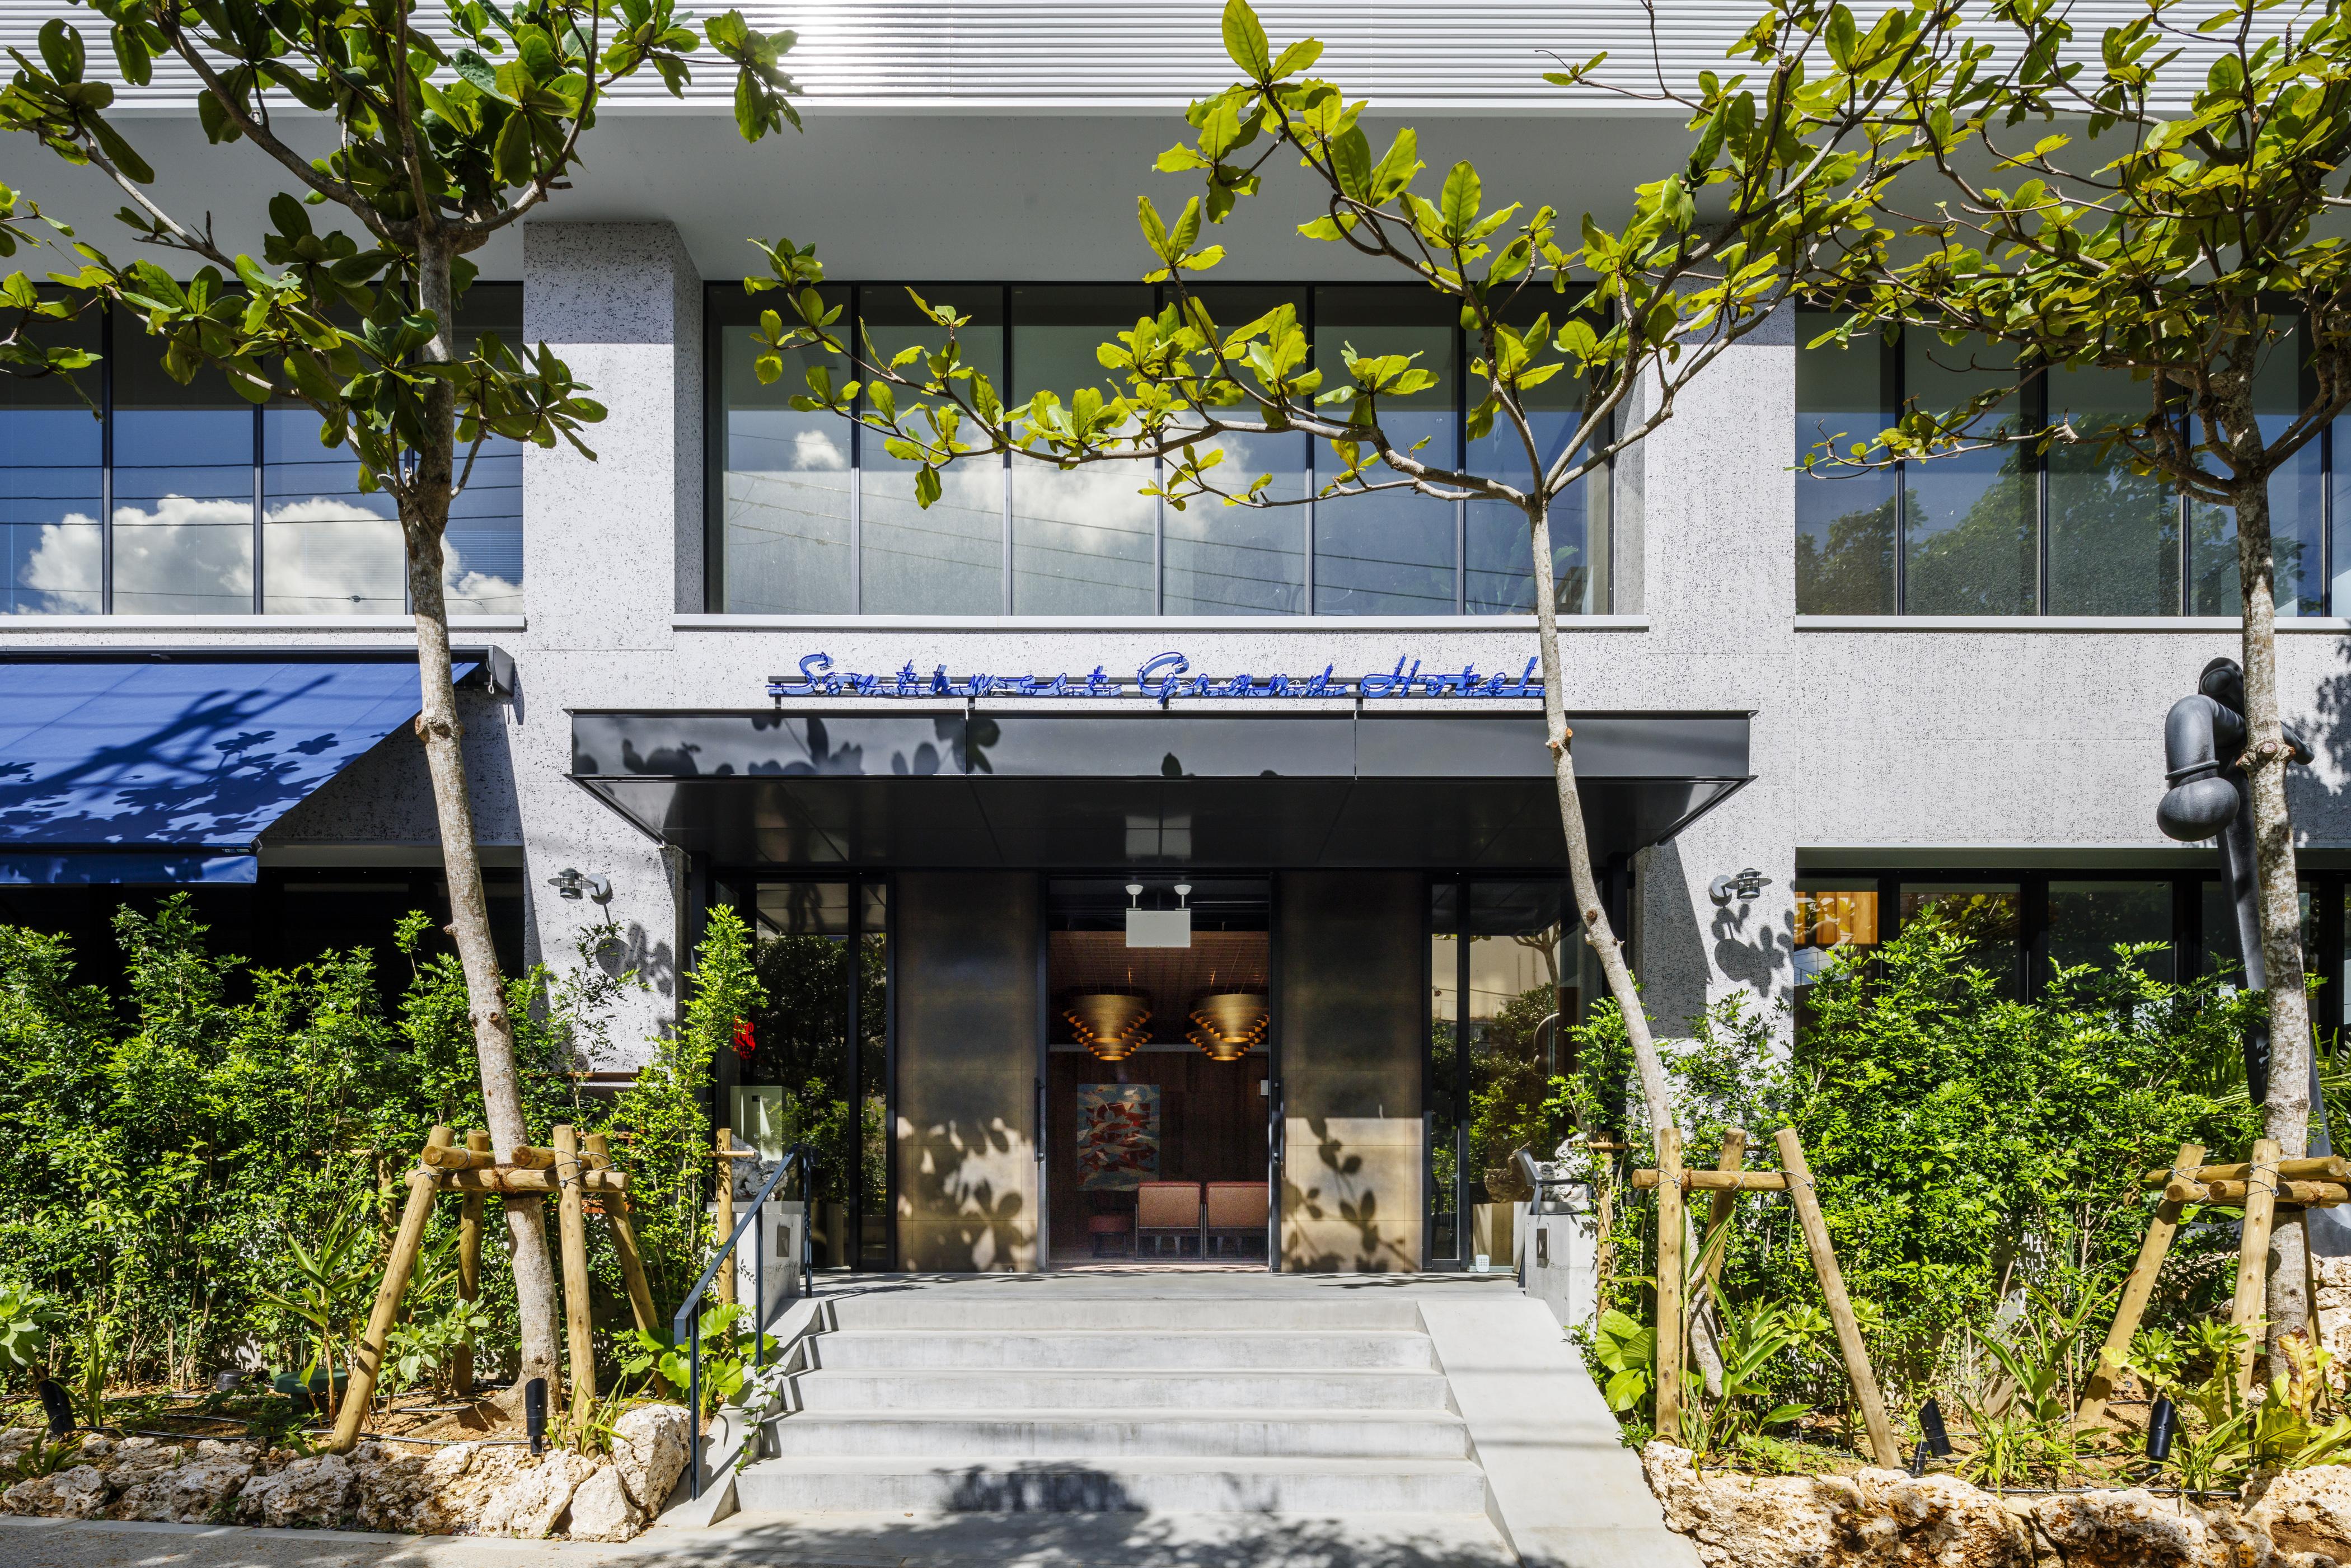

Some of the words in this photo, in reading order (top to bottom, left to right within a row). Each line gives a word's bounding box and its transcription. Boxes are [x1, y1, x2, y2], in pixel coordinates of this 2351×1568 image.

[765, 651, 1122, 696] Southwest
[1136, 651, 1350, 704] Grand
[1360, 653, 1546, 698] Hotel
